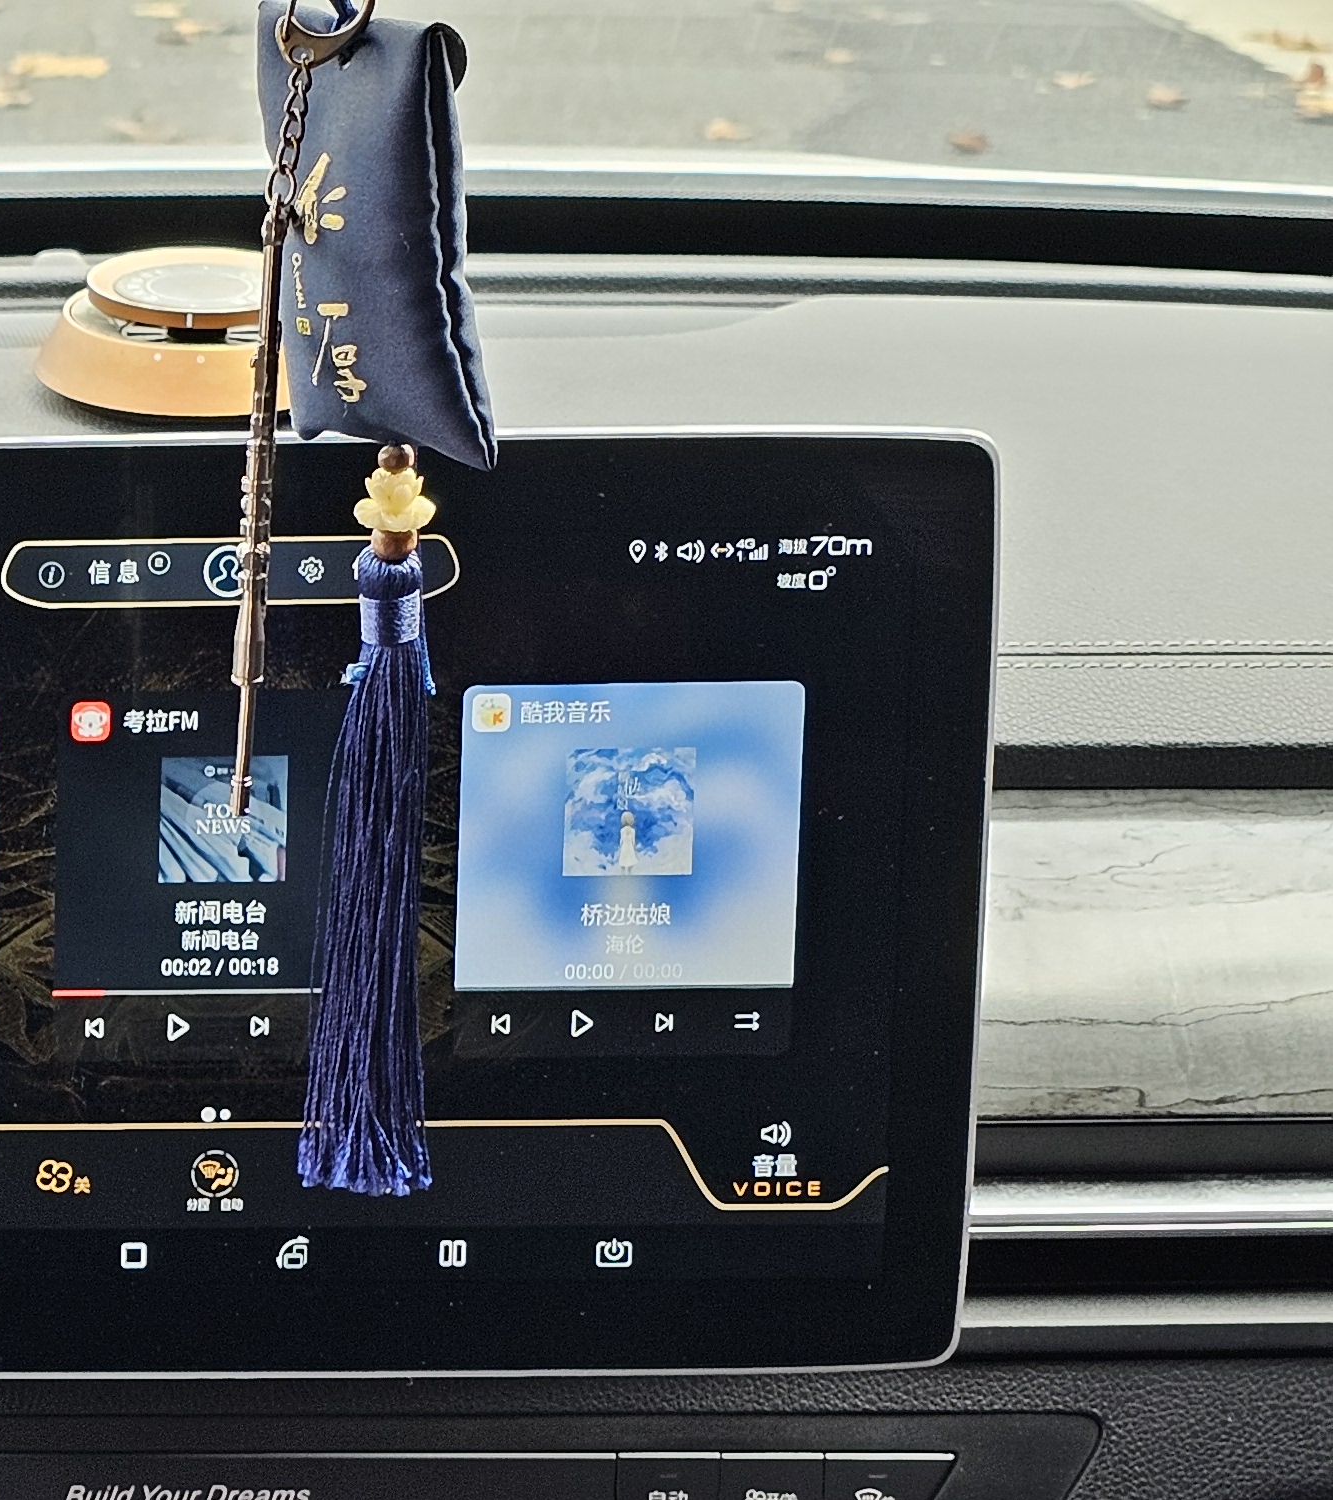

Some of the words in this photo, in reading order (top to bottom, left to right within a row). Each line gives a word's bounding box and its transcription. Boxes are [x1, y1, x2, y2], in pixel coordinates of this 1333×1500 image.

[810, 535, 873, 556] 70m
[87, 558, 140, 586] 信息
[123, 709, 200, 734] 考拉FM
[520, 700, 612, 725] 酷我音乐
[204, 802, 242, 819] TO
[195, 818, 251, 836] NEWS
[174, 899, 268, 926] 新闻电台
[580, 902, 672, 927] 桥边姑娘
[181, 928, 260, 952] 新闻电台
[605, 933, 646, 955] 海伦
[160, 957, 213, 977] 00:02
[228, 956, 280, 977] 00:18
[564, 962, 615, 981] 00:00
[633, 962, 683, 980] 00:00
[751, 1153, 799, 1178] 音量
[733, 1180, 822, 1198] VOICE
